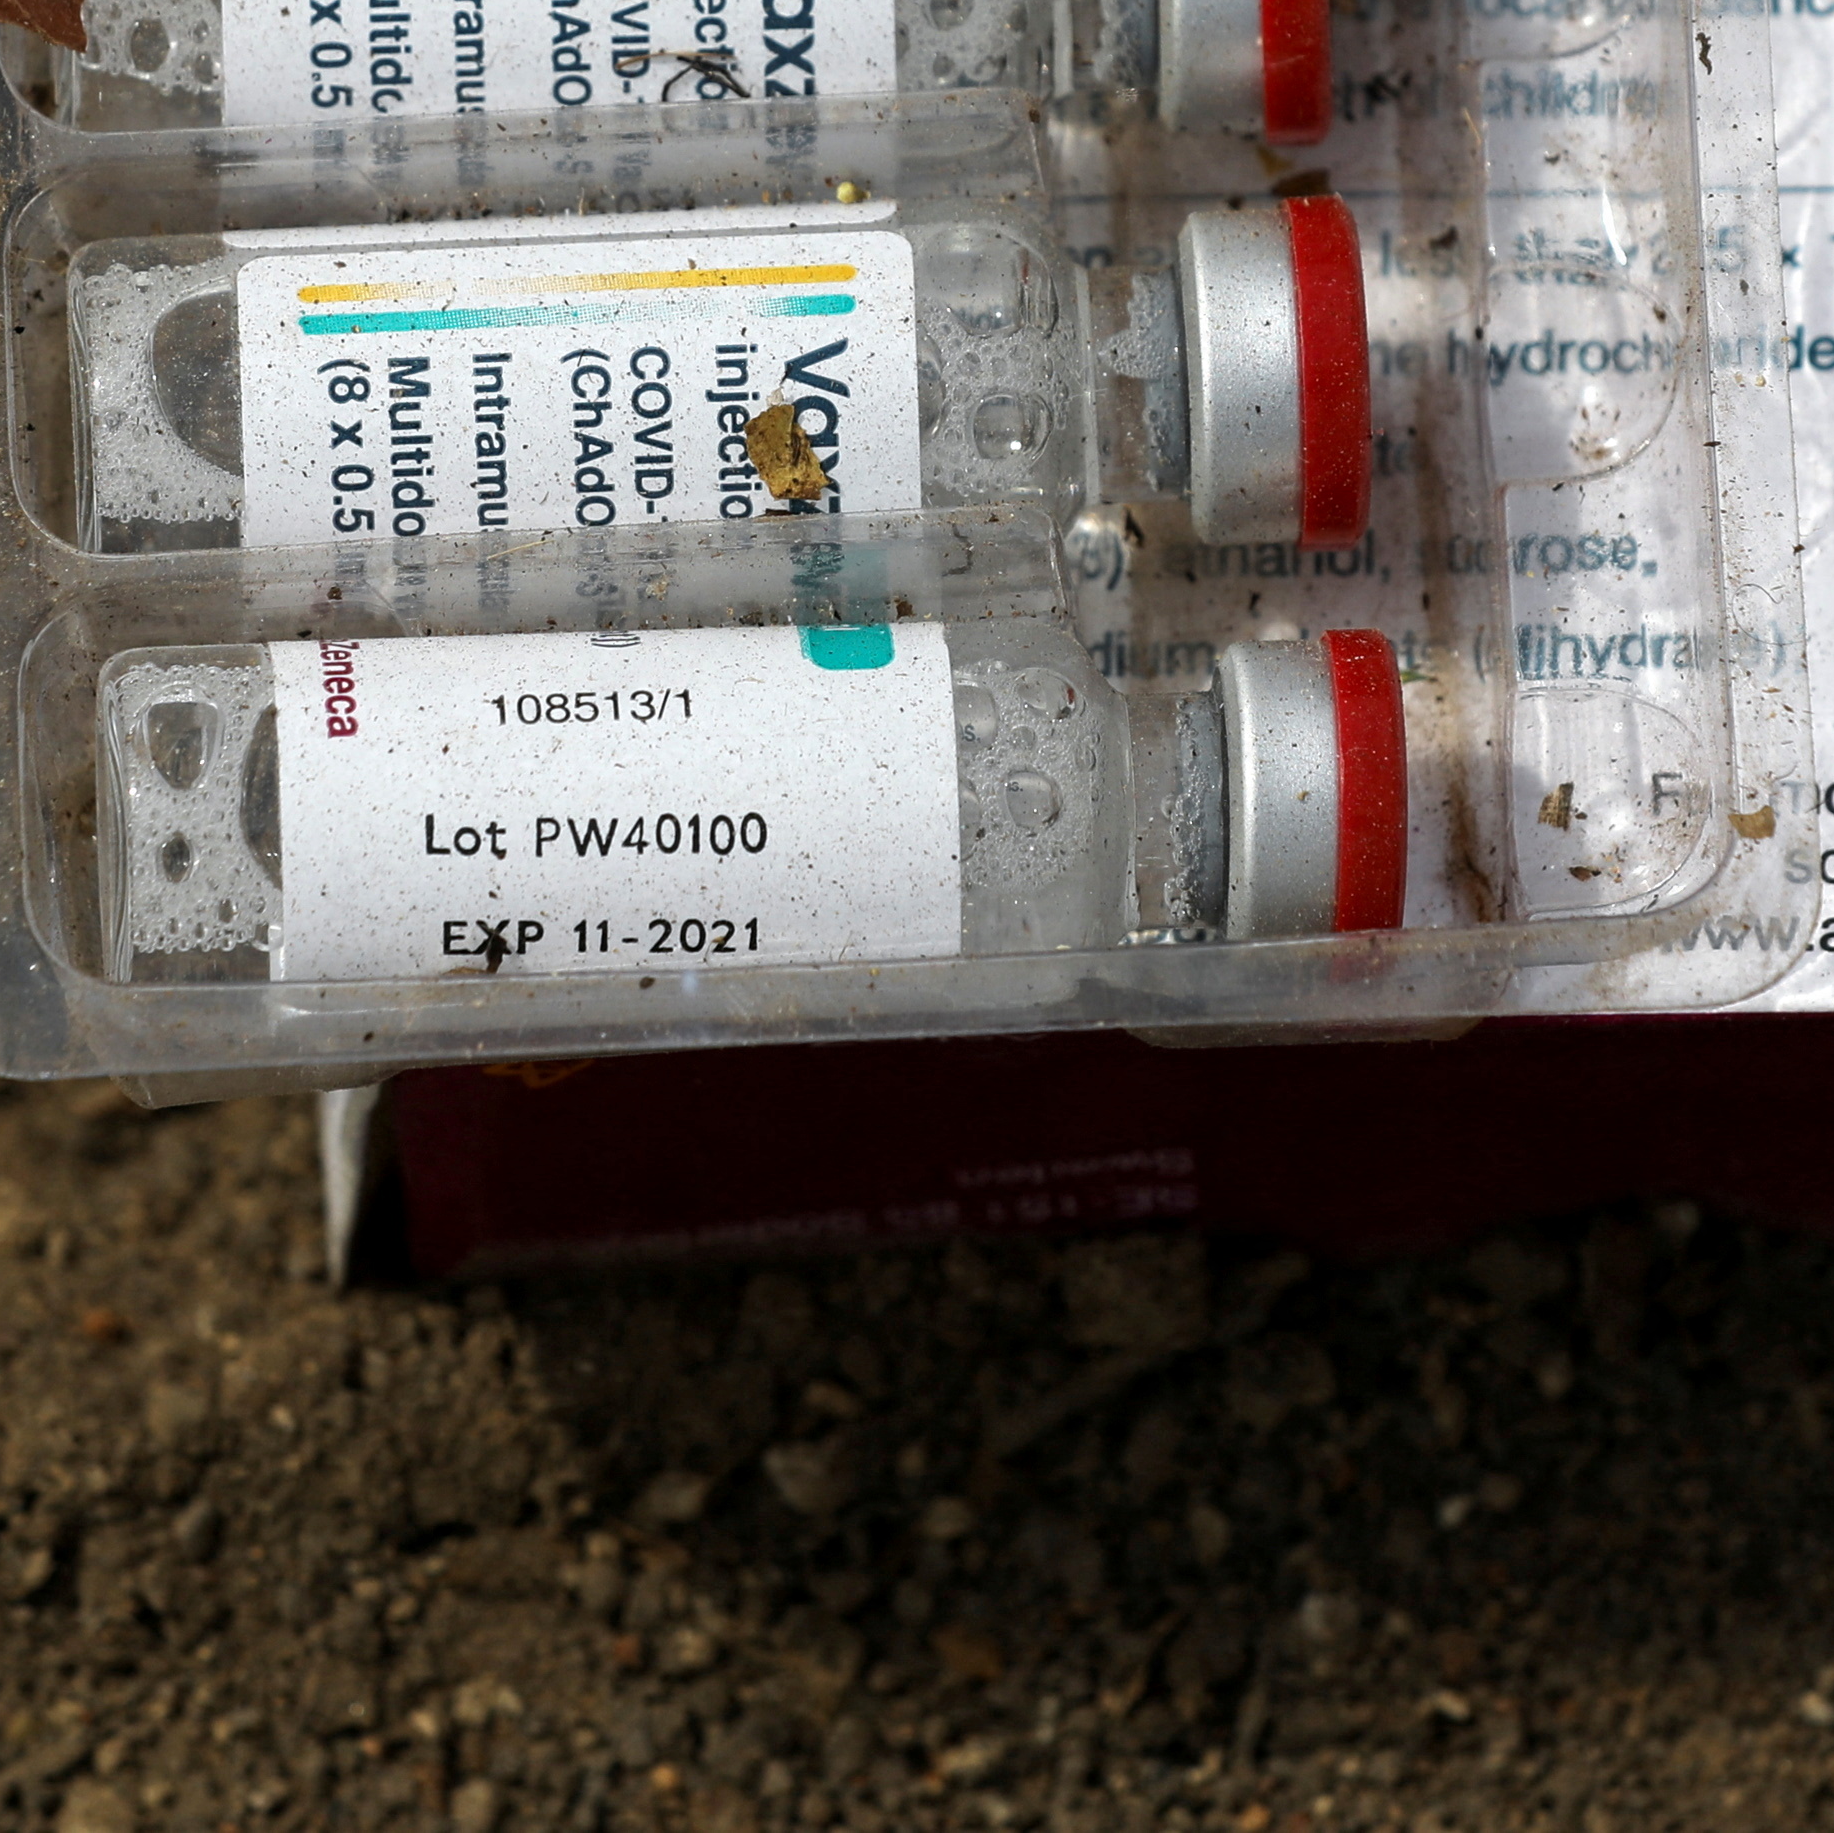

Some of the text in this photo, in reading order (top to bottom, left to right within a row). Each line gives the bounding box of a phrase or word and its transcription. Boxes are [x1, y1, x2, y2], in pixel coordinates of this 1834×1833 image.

[310, 41, 353, 108] 0.5
[317, 358, 375, 533] (8 x 0.5
[387, 355, 435, 537] Multido
[472, 352, 512, 532] Intramu
[560, 347, 616, 527] (ChAdO
[630, 345, 674, 522] COVID-
[705, 342, 764, 520] injectio
[491, 688, 694, 726] 108513/1
[425, 812, 768, 858] Lot PW40100
[442, 916, 759, 956] EXP 11-2021
